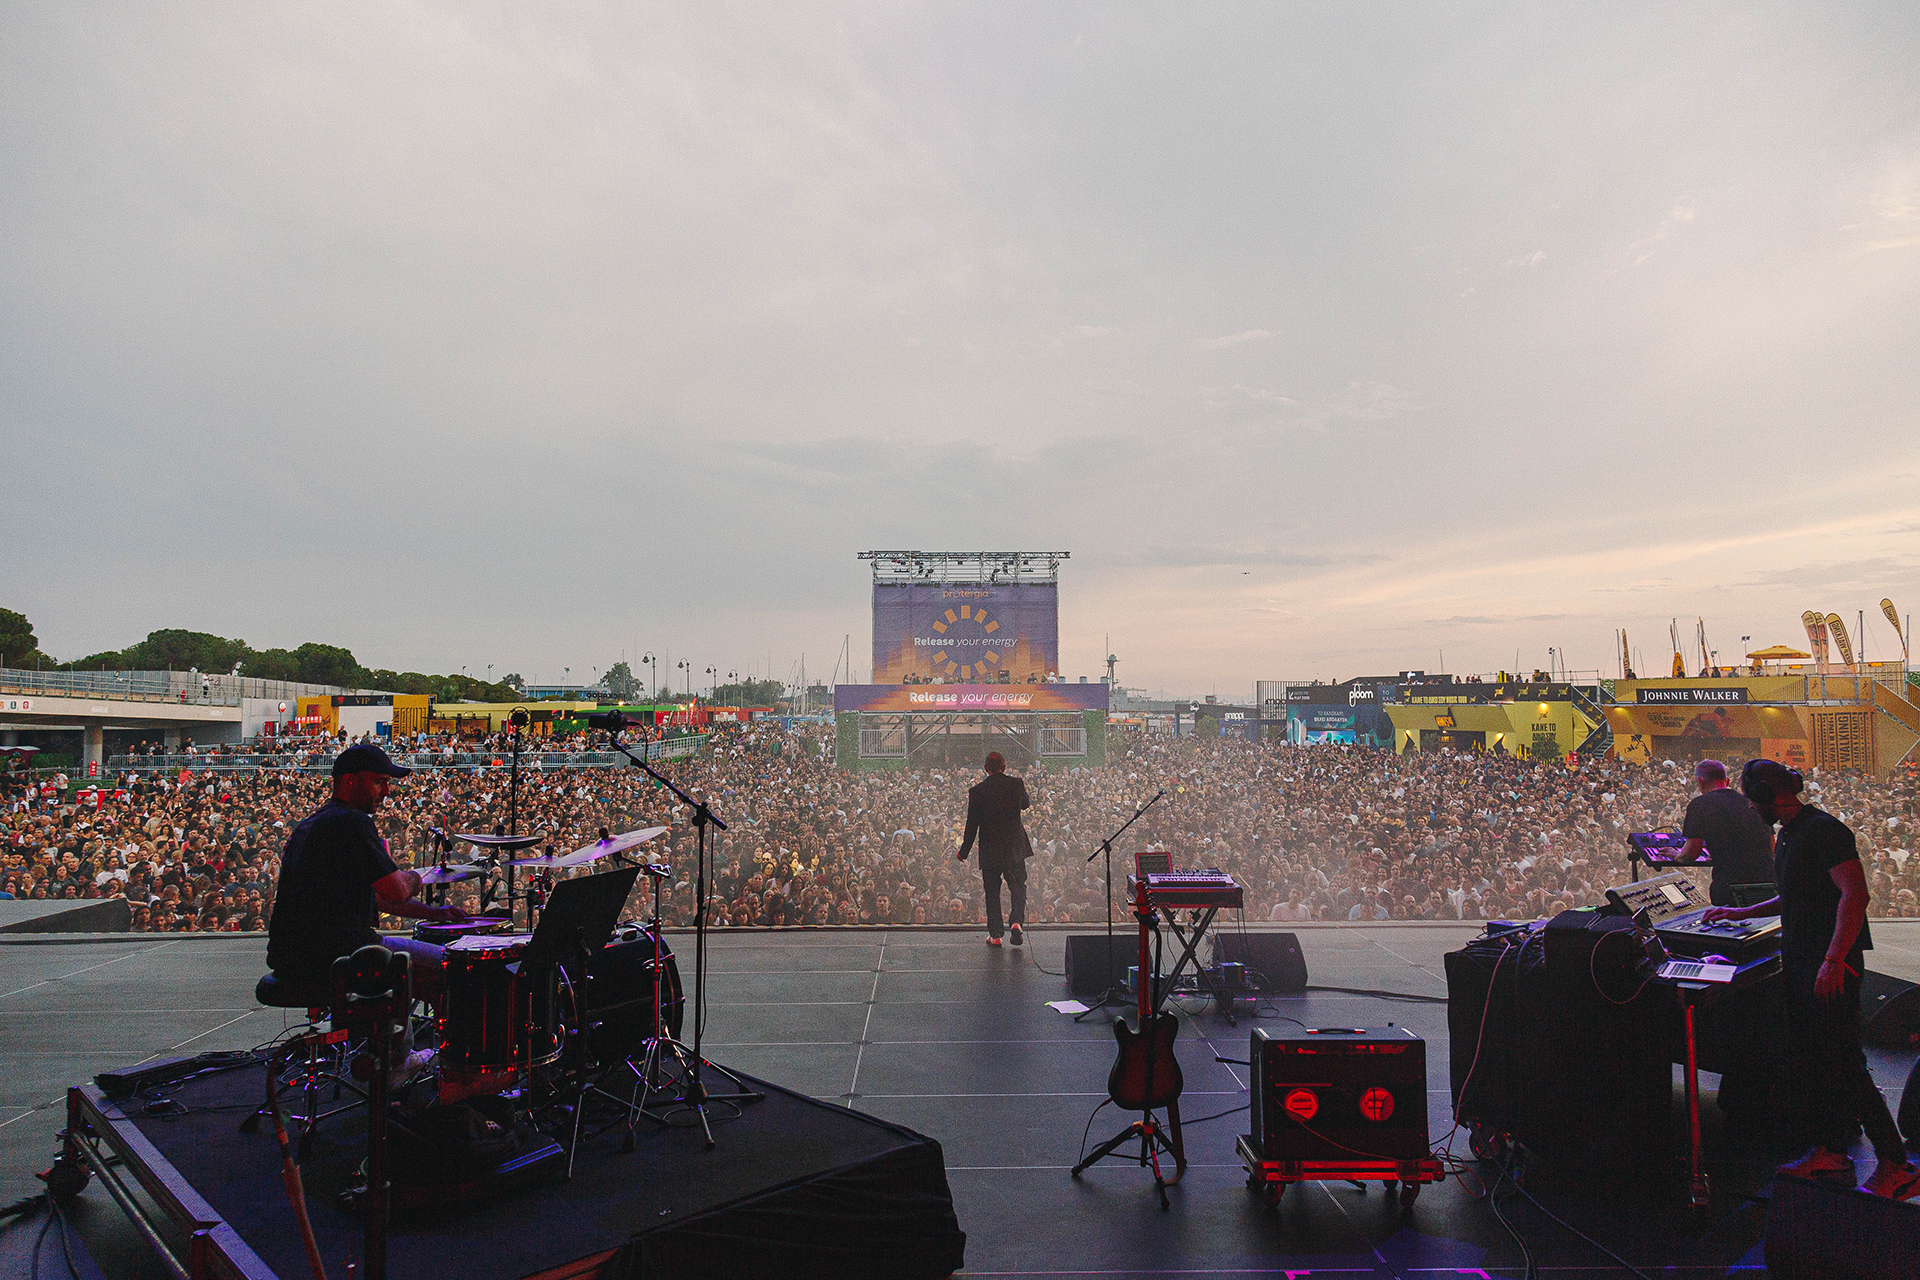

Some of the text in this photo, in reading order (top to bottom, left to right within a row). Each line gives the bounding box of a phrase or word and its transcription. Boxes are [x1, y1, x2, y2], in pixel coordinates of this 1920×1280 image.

[942, 589, 989, 599] protergia
[914, 637, 1017, 648] Release your energy
[909, 692, 1034, 704] Release your energy
[1349, 684, 1374, 708] ploom
[1643, 690, 1739, 702] JOHNNIE WALKER
[1838, 716, 1851, 763] WALKING
